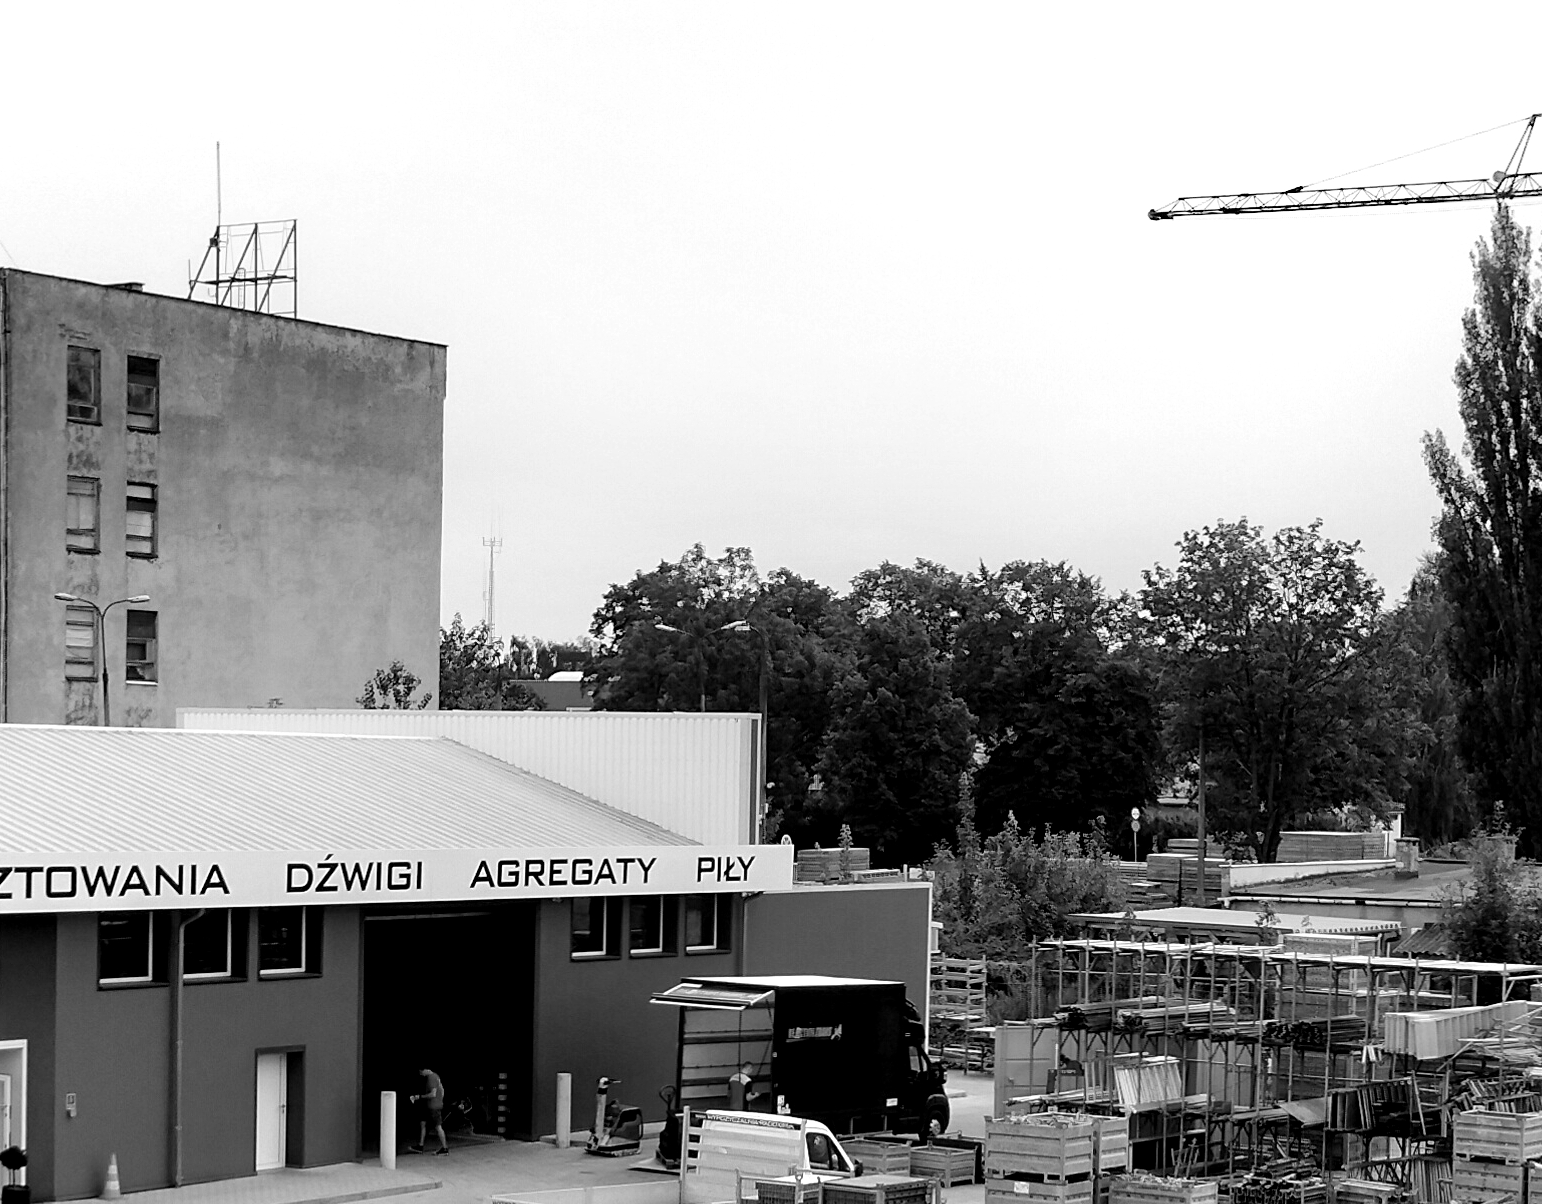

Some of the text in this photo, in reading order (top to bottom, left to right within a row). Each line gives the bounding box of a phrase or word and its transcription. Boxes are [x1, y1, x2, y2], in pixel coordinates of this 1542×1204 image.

[287, 854, 422, 893] DŹWIGI
[470, 857, 657, 889] AGREGATY
[697, 856, 756, 883] PIŁY
